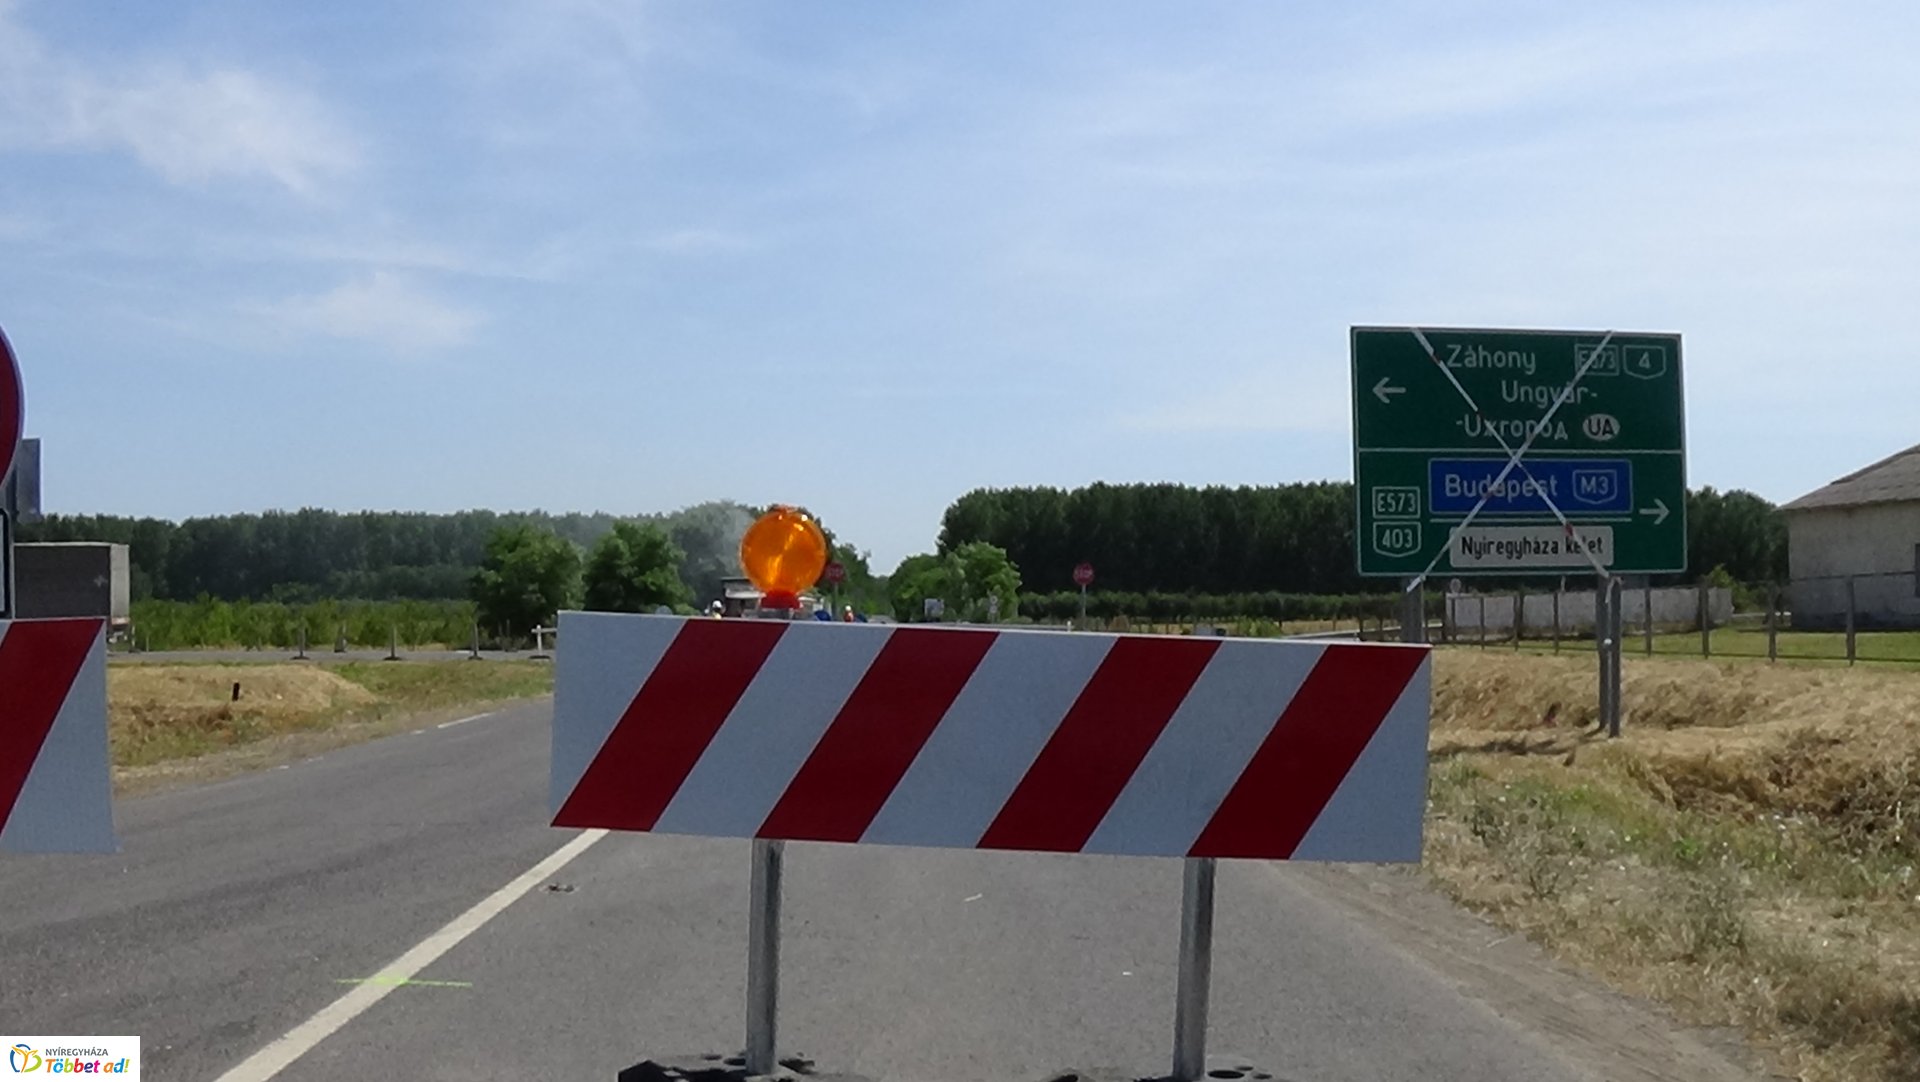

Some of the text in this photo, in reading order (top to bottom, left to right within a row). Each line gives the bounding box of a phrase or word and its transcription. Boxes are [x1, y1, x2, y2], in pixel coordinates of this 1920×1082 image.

[1446, 344, 1536, 375] Záhony
[1638, 351, 1651, 369] 4
[1587, 417, 1615, 436] UA
[1445, 473, 1558, 503] Budapest
[1580, 476, 1609, 495] M3
[1377, 493, 1416, 513] E573
[1382, 528, 1413, 549] 403
[1565, 536, 1603, 554] keet
